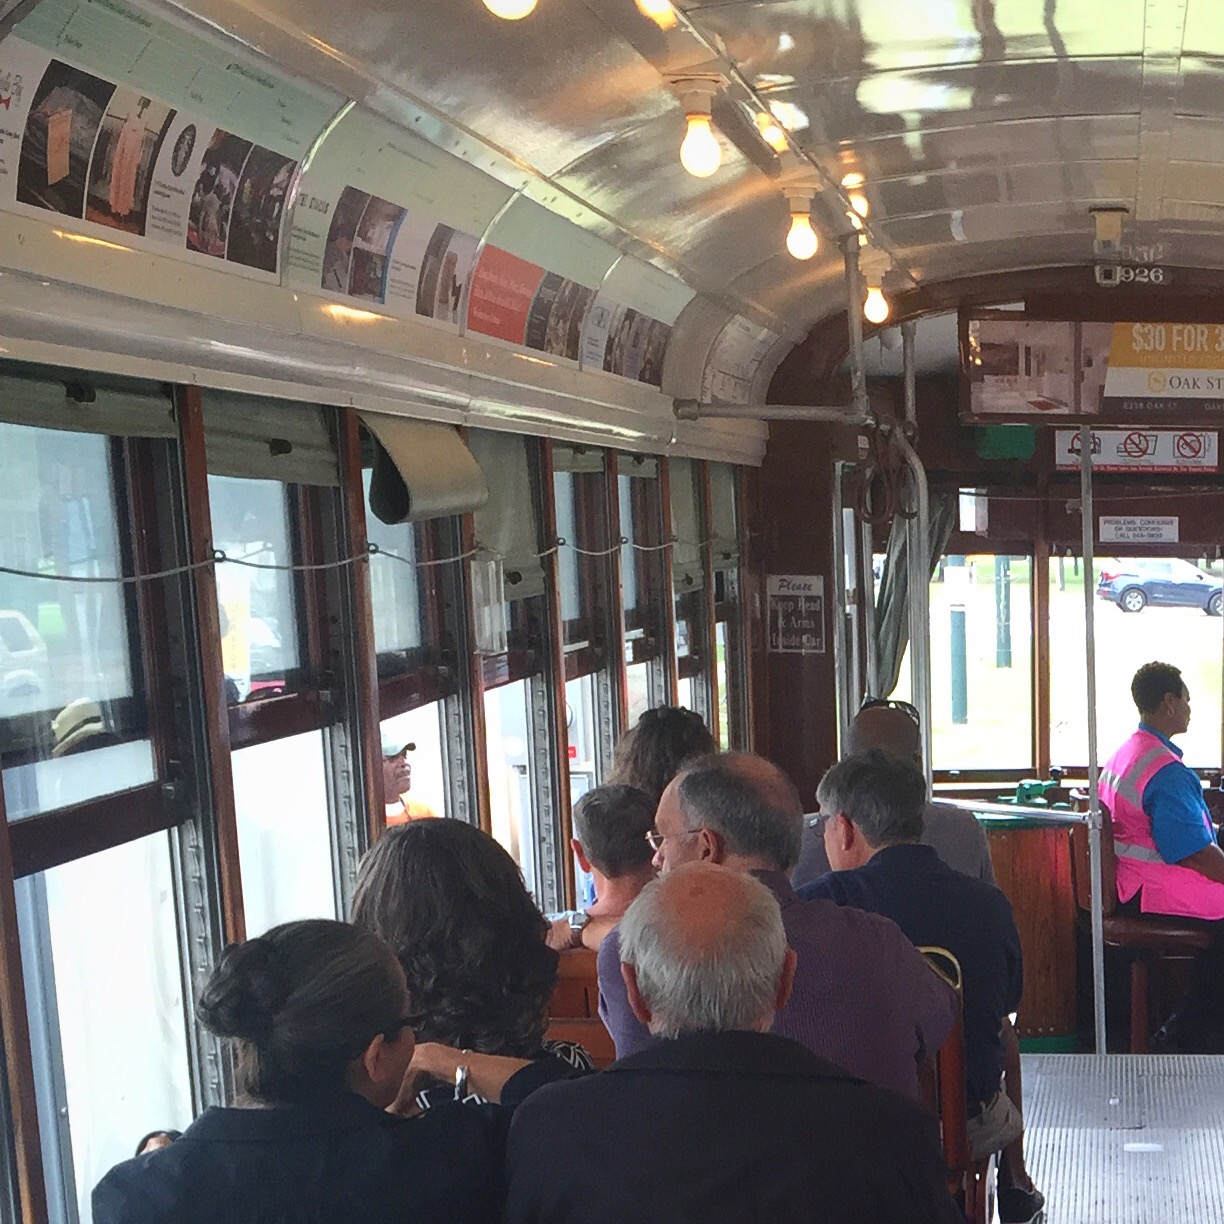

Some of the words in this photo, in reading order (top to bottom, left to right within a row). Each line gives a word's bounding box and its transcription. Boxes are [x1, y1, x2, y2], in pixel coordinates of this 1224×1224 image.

[1120, 267, 1164, 284] 926
[1132, 323, 1167, 353] $30
[1172, 325, 1209, 352] FOR
[1169, 375, 1201, 390] OAK
[778, 578, 814, 592] Please
[791, 616, 816, 629] Arms
